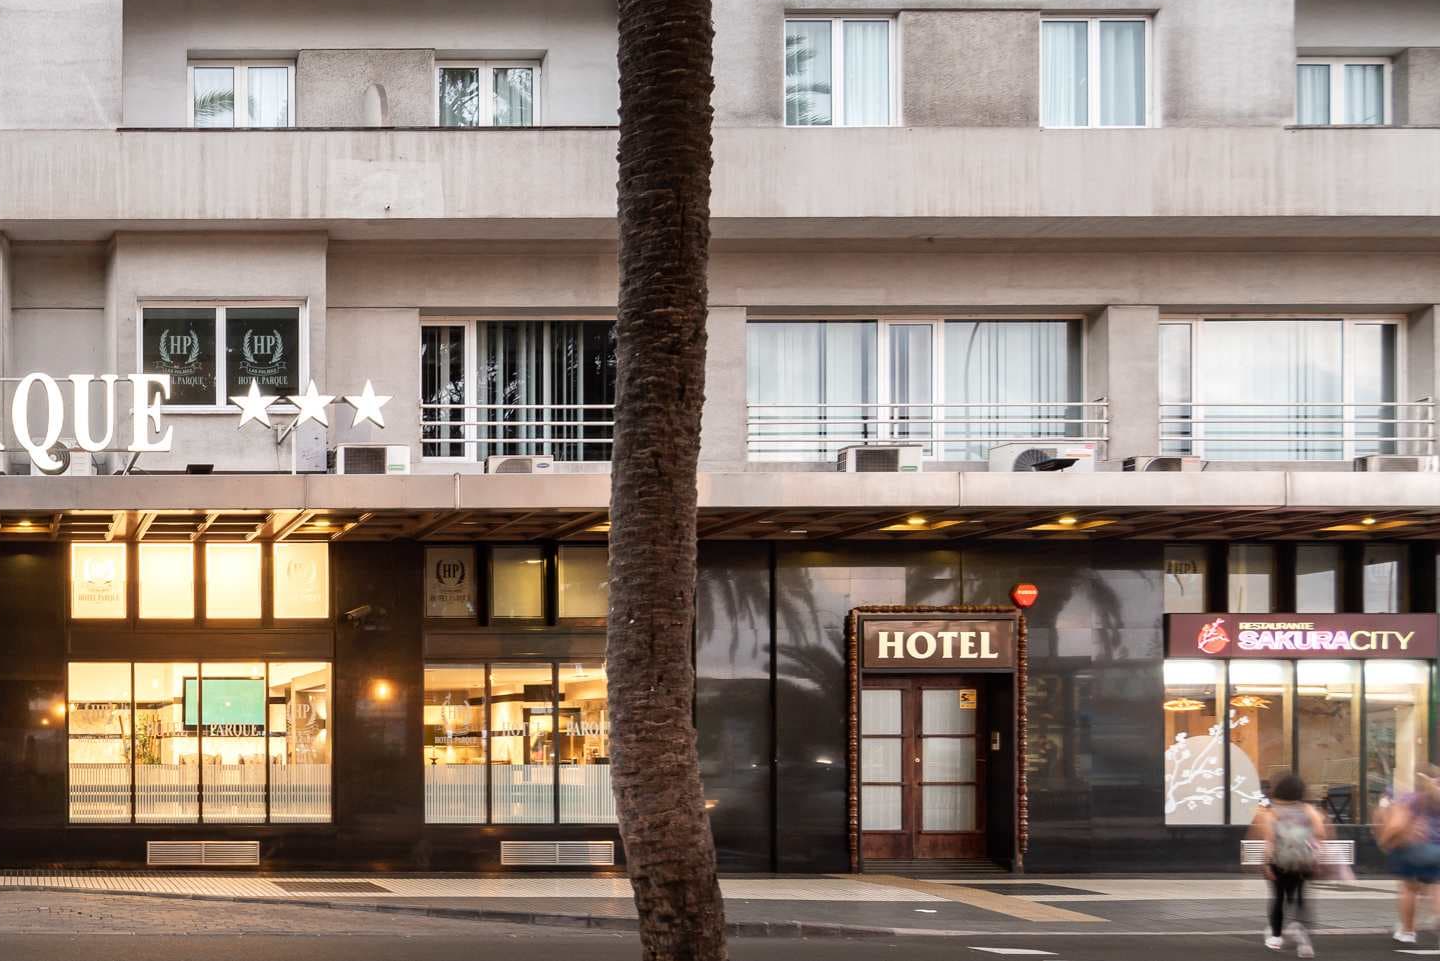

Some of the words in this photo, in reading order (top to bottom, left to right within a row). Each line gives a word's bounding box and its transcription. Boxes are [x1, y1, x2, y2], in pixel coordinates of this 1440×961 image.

[169, 335, 193, 355] HP
[253, 335, 277, 355] HP
[177, 376, 204, 387] PARQUE
[238, 375, 261, 385] HOTL
[261, 375, 288, 387] PARQUE
[442, 563, 460, 578] HP
[1239, 622, 1315, 631] RESTAURANTE
[877, 631, 999, 660] HOTEL
